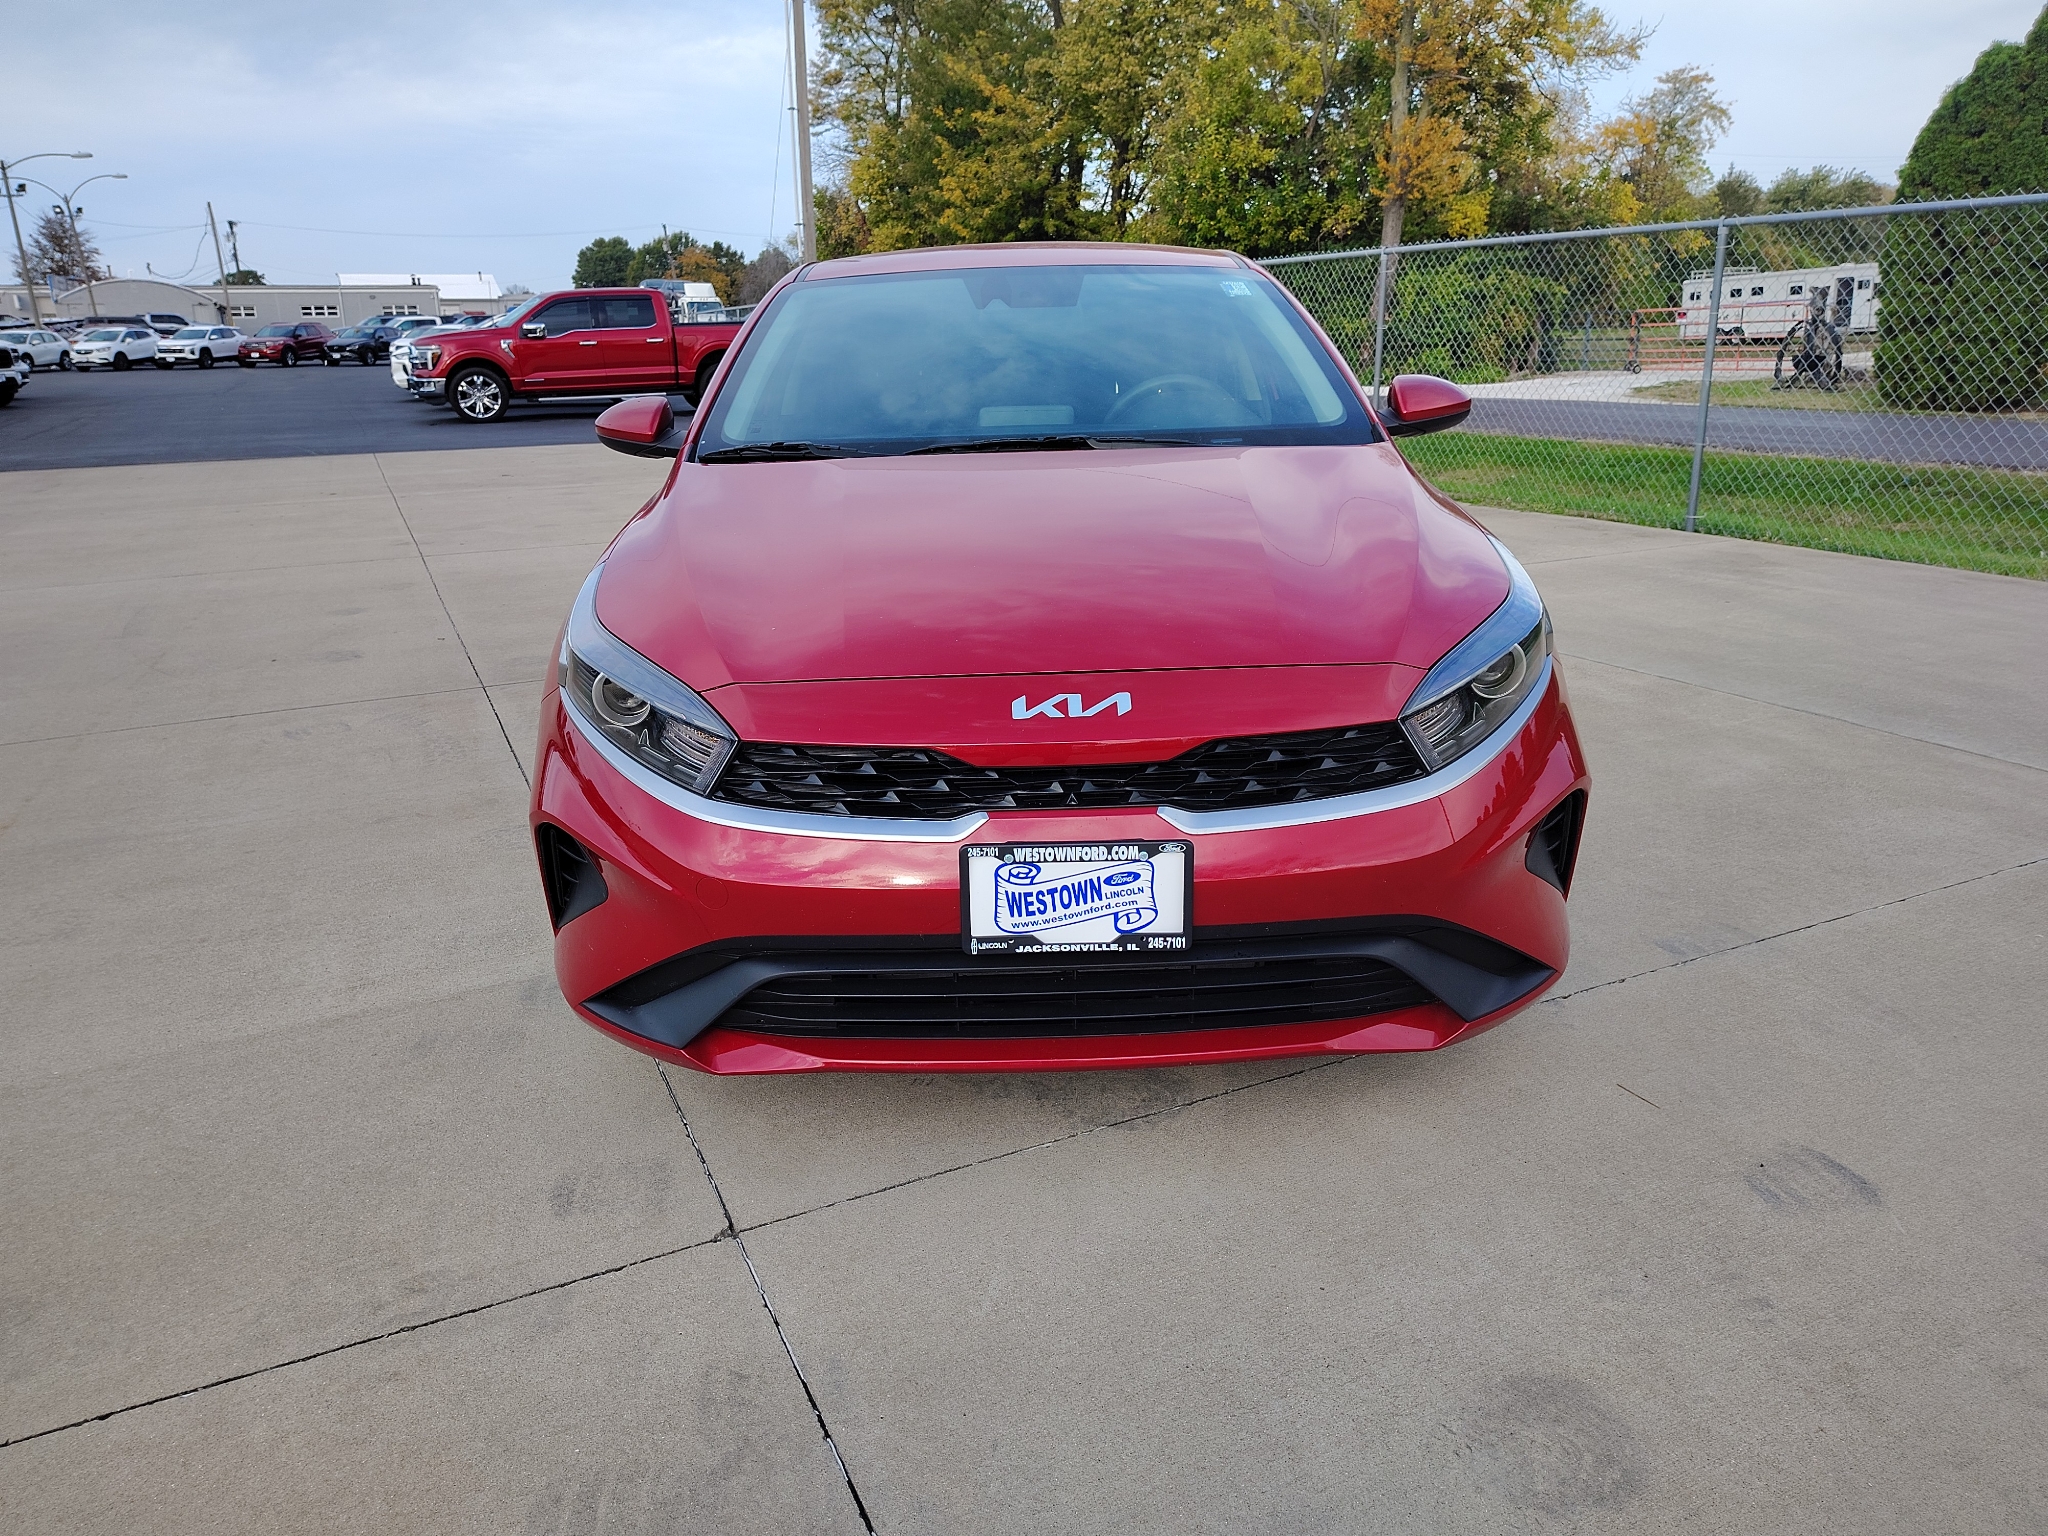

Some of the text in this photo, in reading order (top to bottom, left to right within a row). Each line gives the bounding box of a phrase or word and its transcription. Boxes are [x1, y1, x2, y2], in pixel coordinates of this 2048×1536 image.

[1012, 692, 1132, 719] KIA
[967, 847, 999, 857] 245-7101
[1013, 845, 1139, 862] WESTOWNFORD.COM
[1162, 843, 1183, 853] Ford
[1111, 873, 1134, 885] Ford
[1004, 876, 1103, 918] WESTOWN
[1104, 886, 1144, 900] LINCOLN
[1011, 899, 1138, 928] www.westownford.com
[978, 941, 1008, 950] LINCOLN
[1015, 943, 1140, 953] JACKSONVILLE, IL
[1148, 936, 1186, 949] 245-7101
